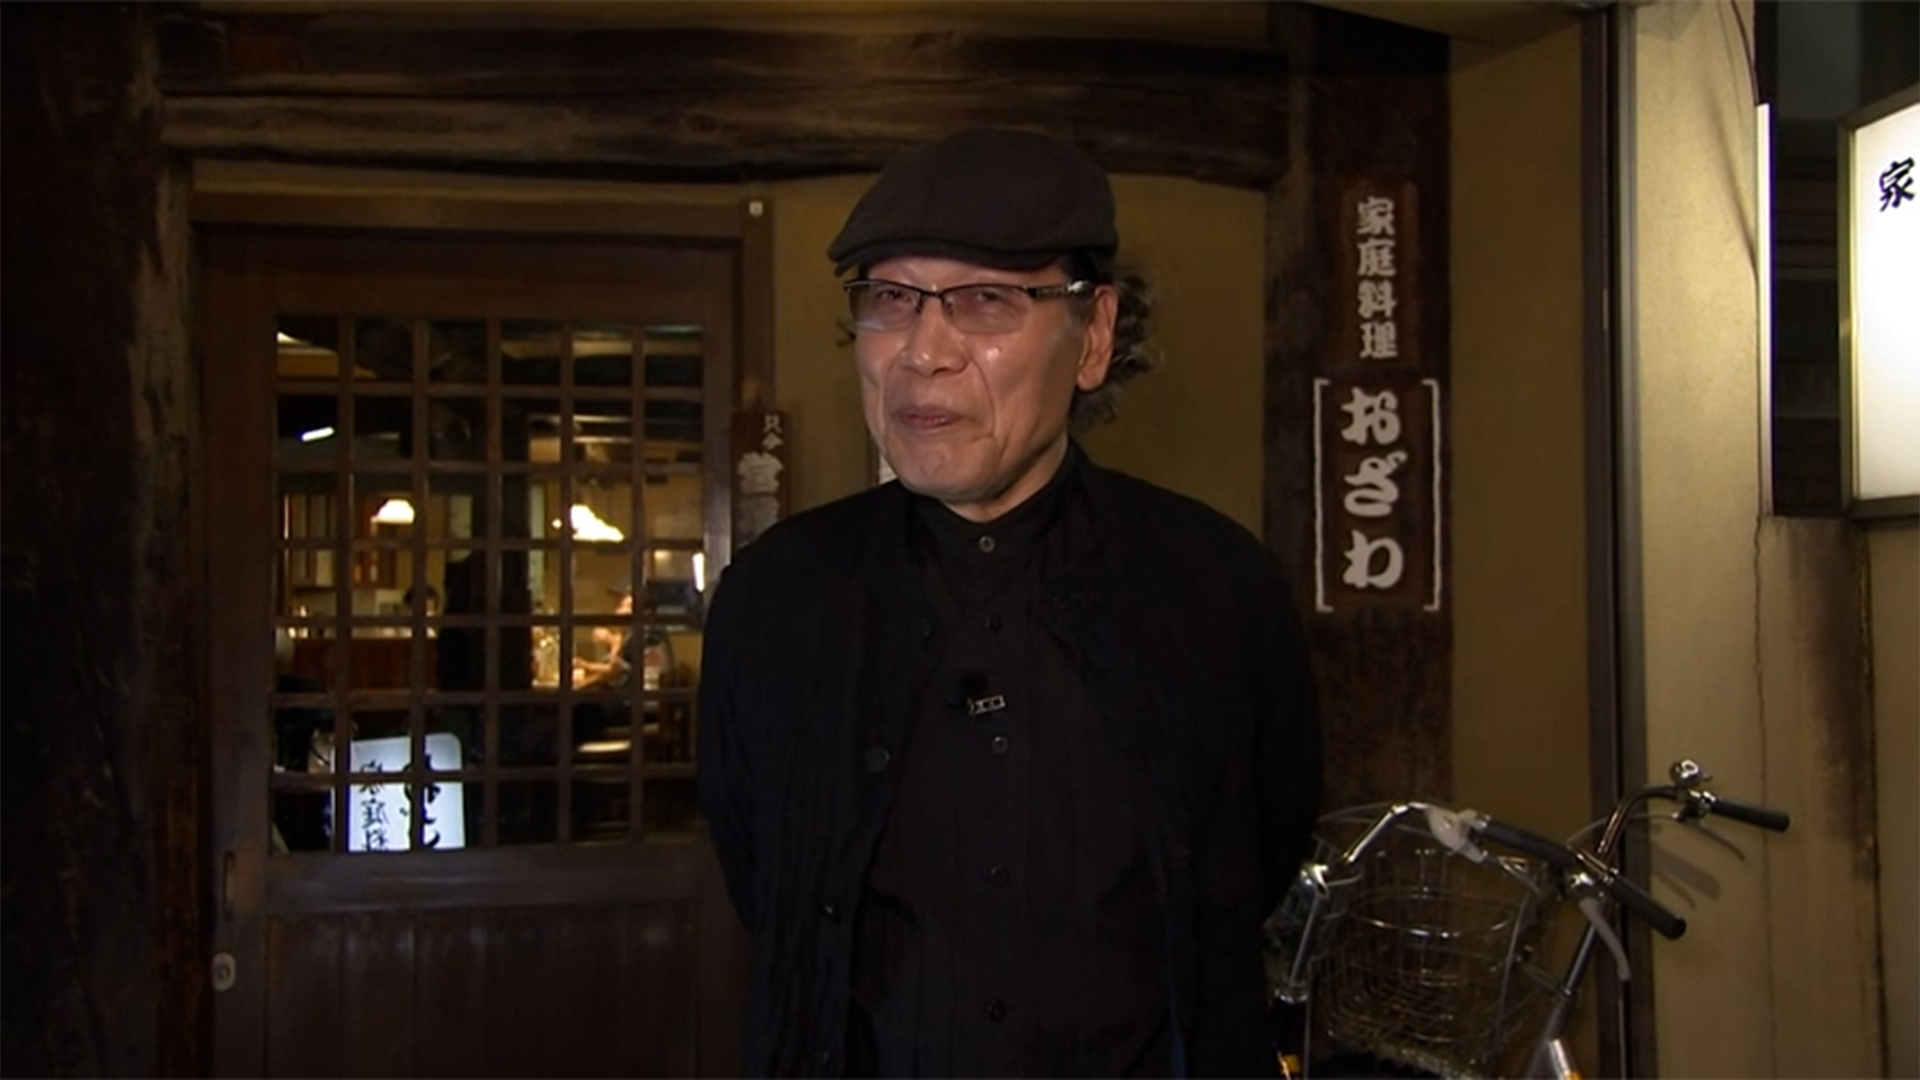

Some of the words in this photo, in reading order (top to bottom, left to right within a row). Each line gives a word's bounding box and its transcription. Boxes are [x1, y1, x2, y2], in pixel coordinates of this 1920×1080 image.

[1879, 157, 1915, 213] 家
[1356, 196, 1398, 359] 家庭料理
[1341, 387, 1407, 588] おざわ
